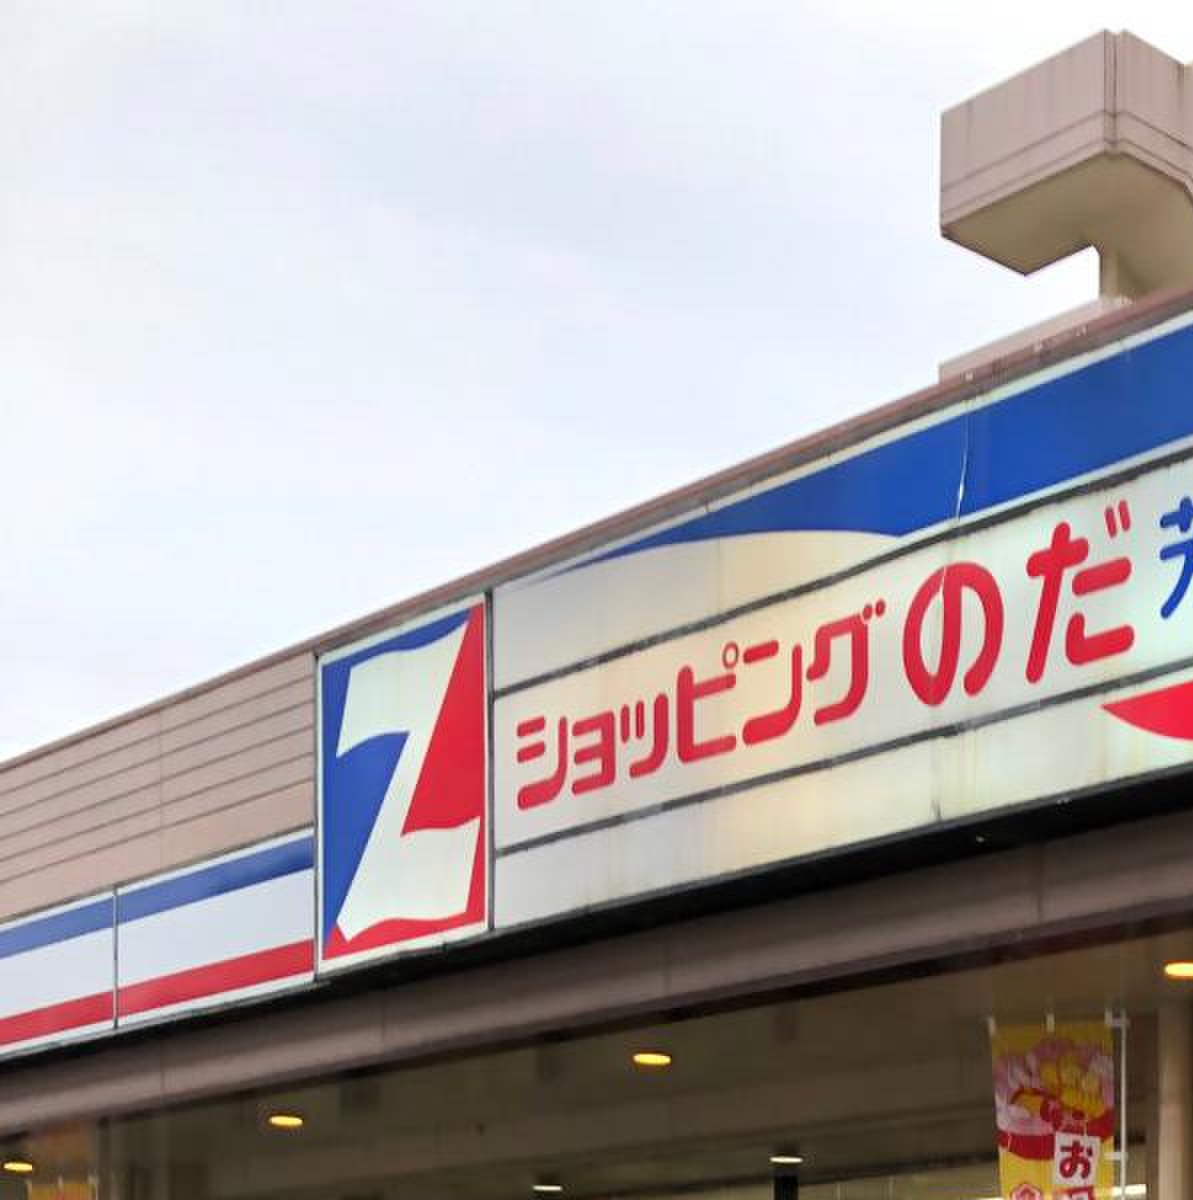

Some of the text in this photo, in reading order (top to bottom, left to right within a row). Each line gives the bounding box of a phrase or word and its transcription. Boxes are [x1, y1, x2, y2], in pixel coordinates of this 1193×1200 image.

[516, 600, 886, 811] ショッピング
[902, 499, 1135, 706] のだ
